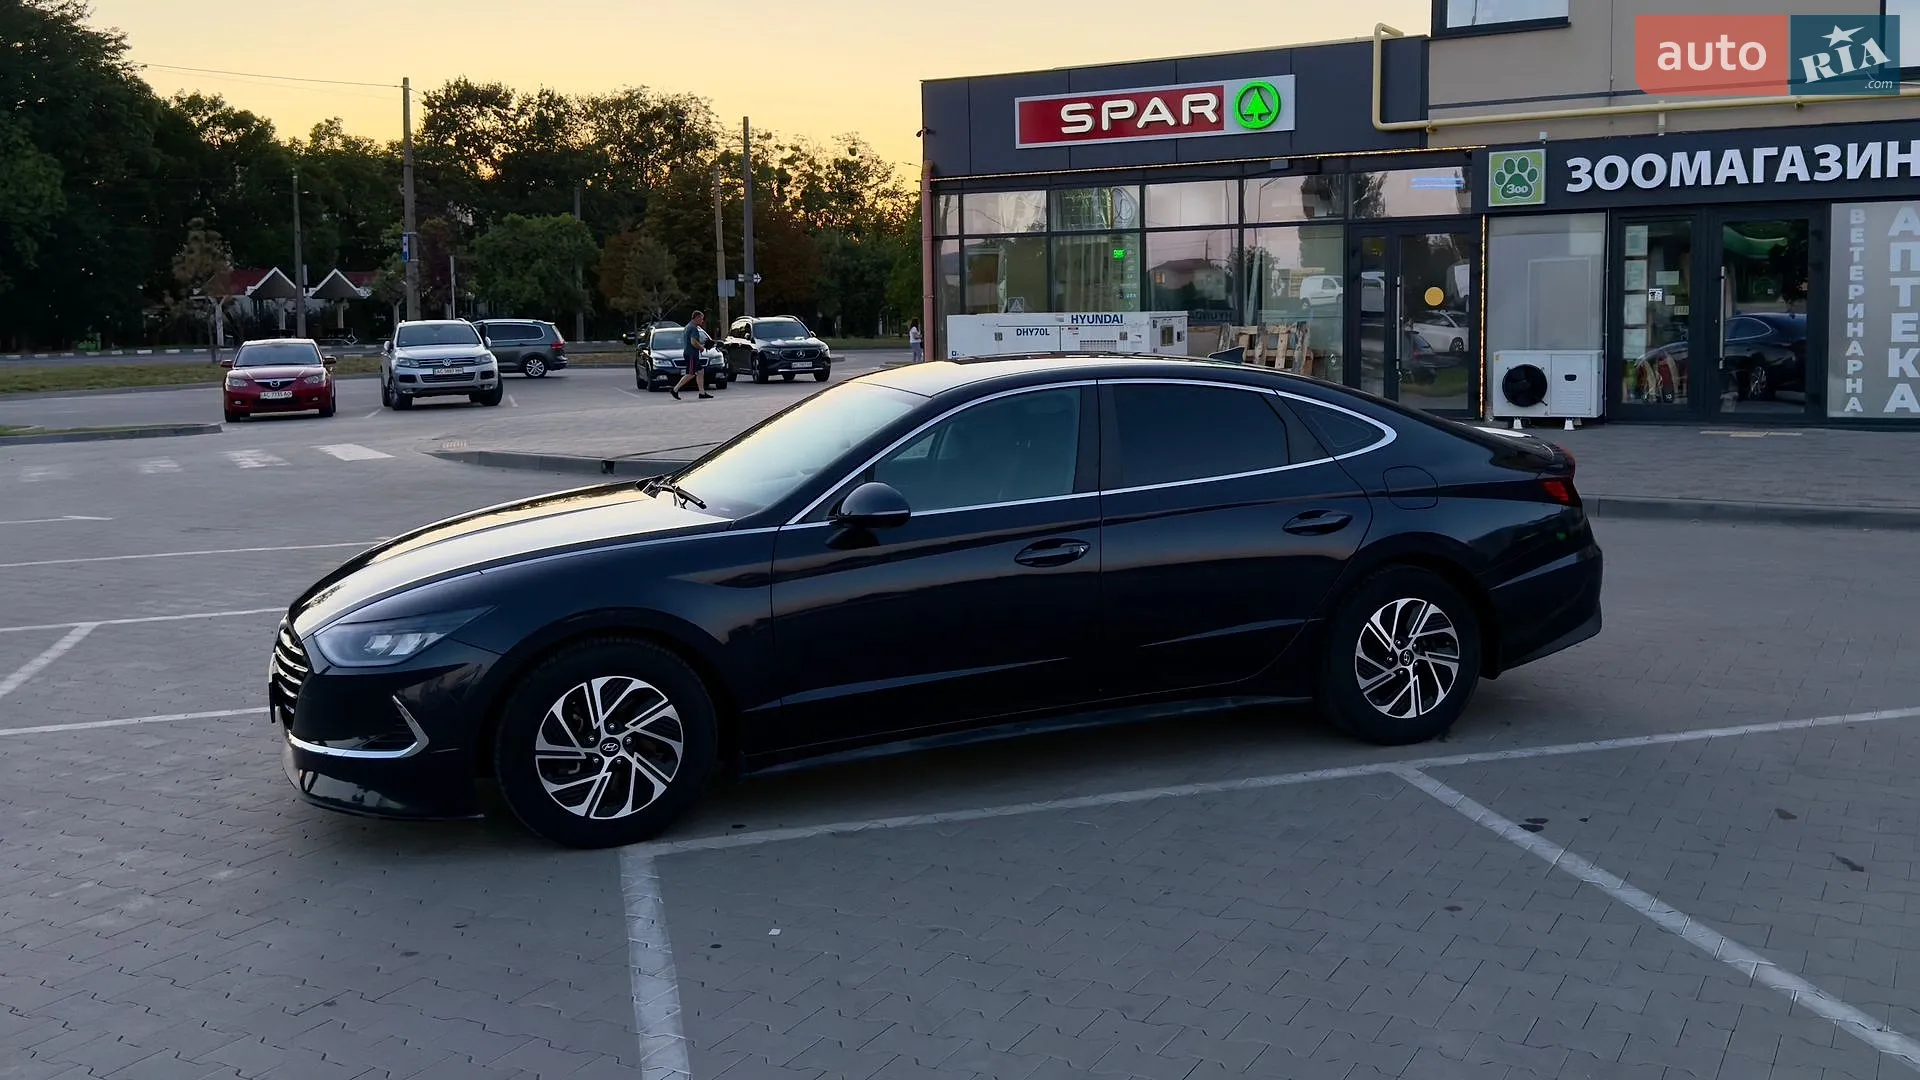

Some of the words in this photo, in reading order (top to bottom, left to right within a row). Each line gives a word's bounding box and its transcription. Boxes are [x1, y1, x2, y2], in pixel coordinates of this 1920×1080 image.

[1060, 92, 1219, 134] SPAR
[1565, 139, 1920, 193] ЗООМАГАЗИН
[1016, 327, 1050, 336] DHY70L
[1071, 314, 1123, 324] HYUNDAI
[1844, 208, 1866, 412] ВЕТЕРИНАРНА
[1883, 206, 1920, 413] АПТЕКА
